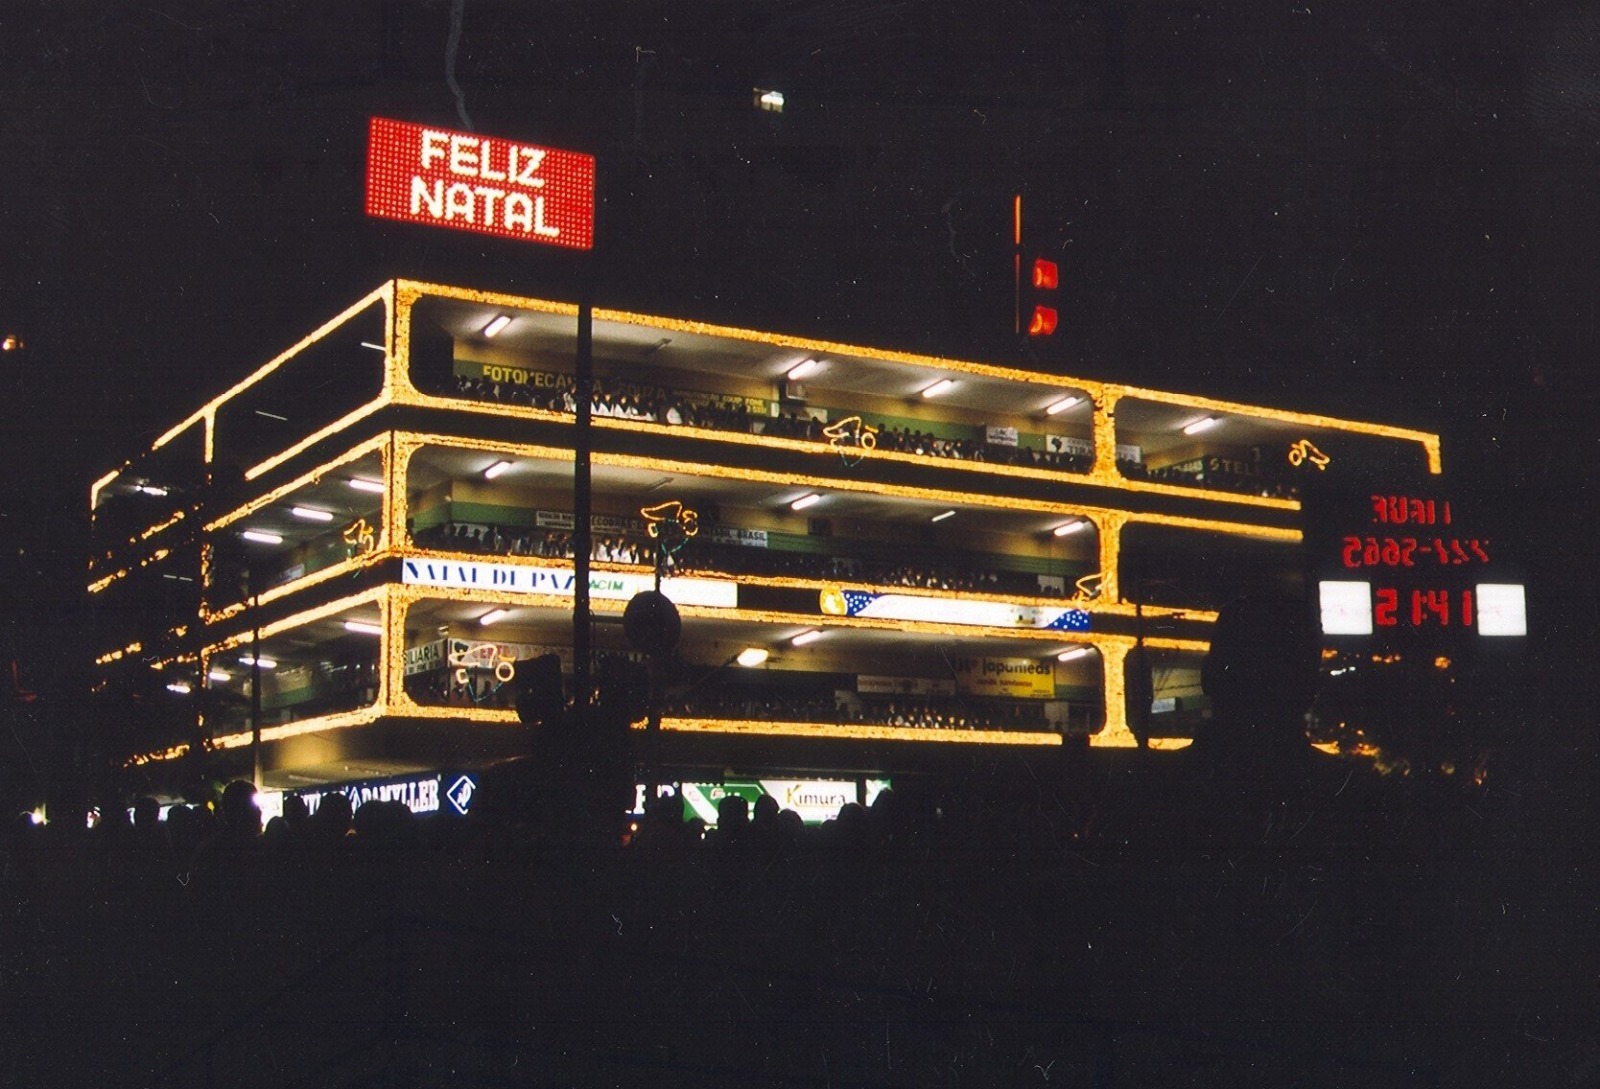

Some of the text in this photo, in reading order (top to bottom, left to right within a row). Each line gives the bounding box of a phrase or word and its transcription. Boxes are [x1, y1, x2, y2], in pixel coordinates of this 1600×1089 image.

[421, 129, 545, 188] FELIZ
[409, 175, 560, 238] NATAL
[784, 784, 845, 807] Kimura
